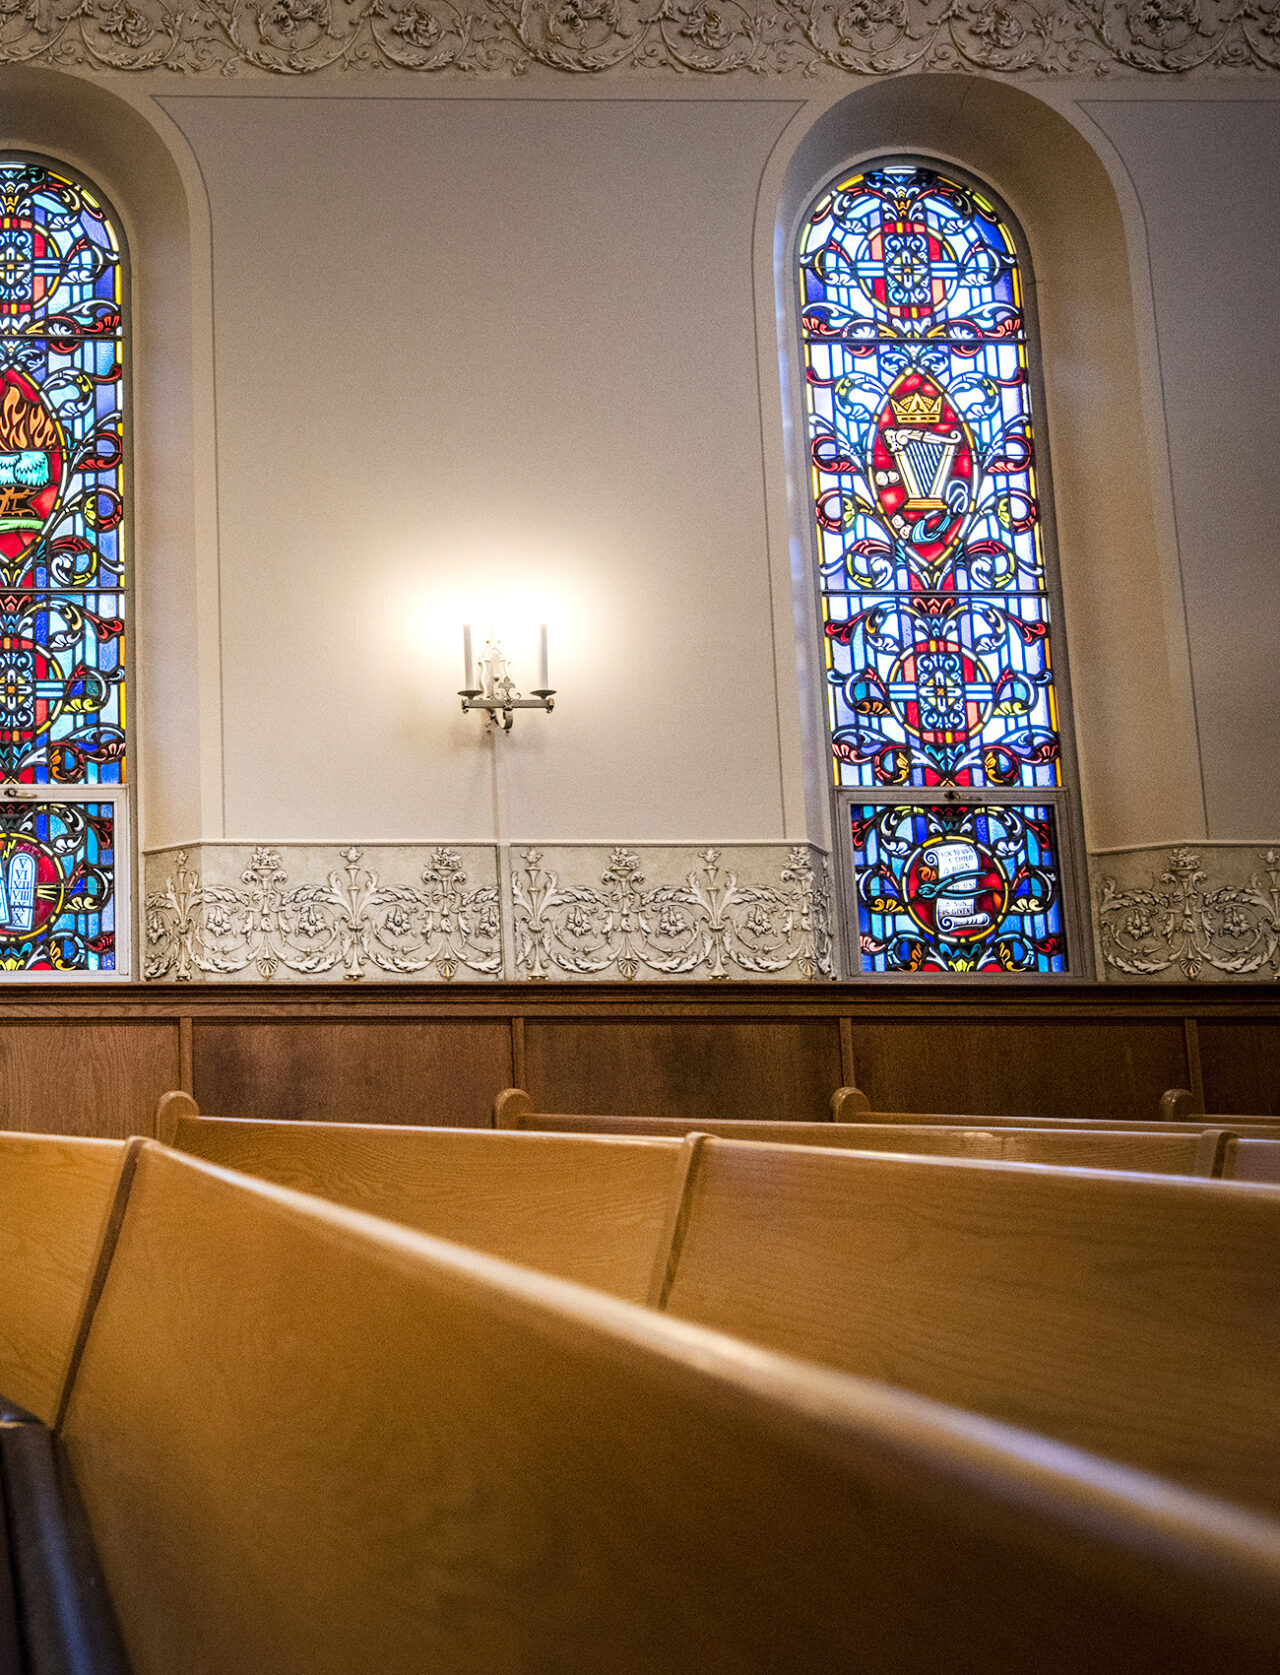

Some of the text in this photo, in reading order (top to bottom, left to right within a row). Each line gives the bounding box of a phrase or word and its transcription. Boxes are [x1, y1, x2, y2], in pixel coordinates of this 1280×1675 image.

[18, 858, 28, 869] V
[955, 855, 973, 863] CHILD
[952, 863, 969, 872] BORN
[15, 869, 28, 880] VI
[14, 880, 30, 890] VII
[12, 889, 30, 900] VIII
[13, 901, 26, 912] IX
[12, 912, 25, 924] X
